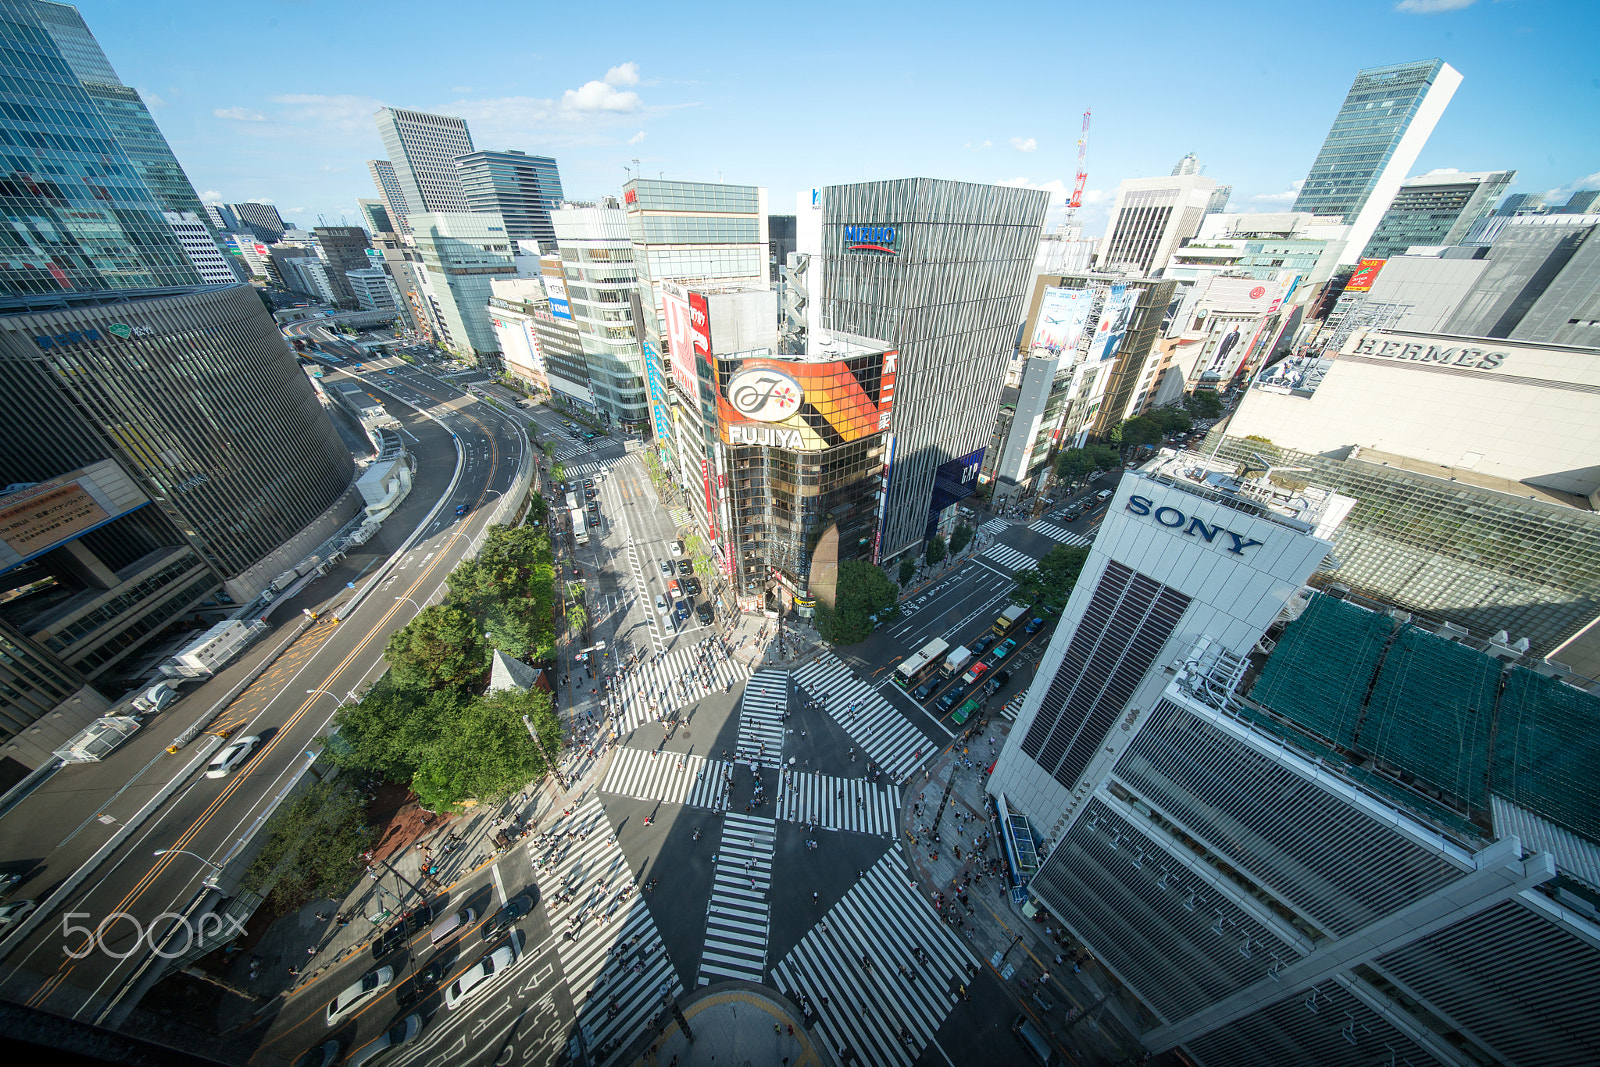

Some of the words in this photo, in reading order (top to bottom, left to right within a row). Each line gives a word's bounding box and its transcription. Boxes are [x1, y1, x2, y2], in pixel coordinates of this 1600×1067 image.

[844, 226, 895, 243] MIZUHO
[1353, 337, 1511, 371] HERMES
[878, 354, 898, 431] 不二家
[729, 425, 806, 449] FUJIYA
[961, 462, 978, 484] GAP
[1126, 494, 1263, 556] SONY
